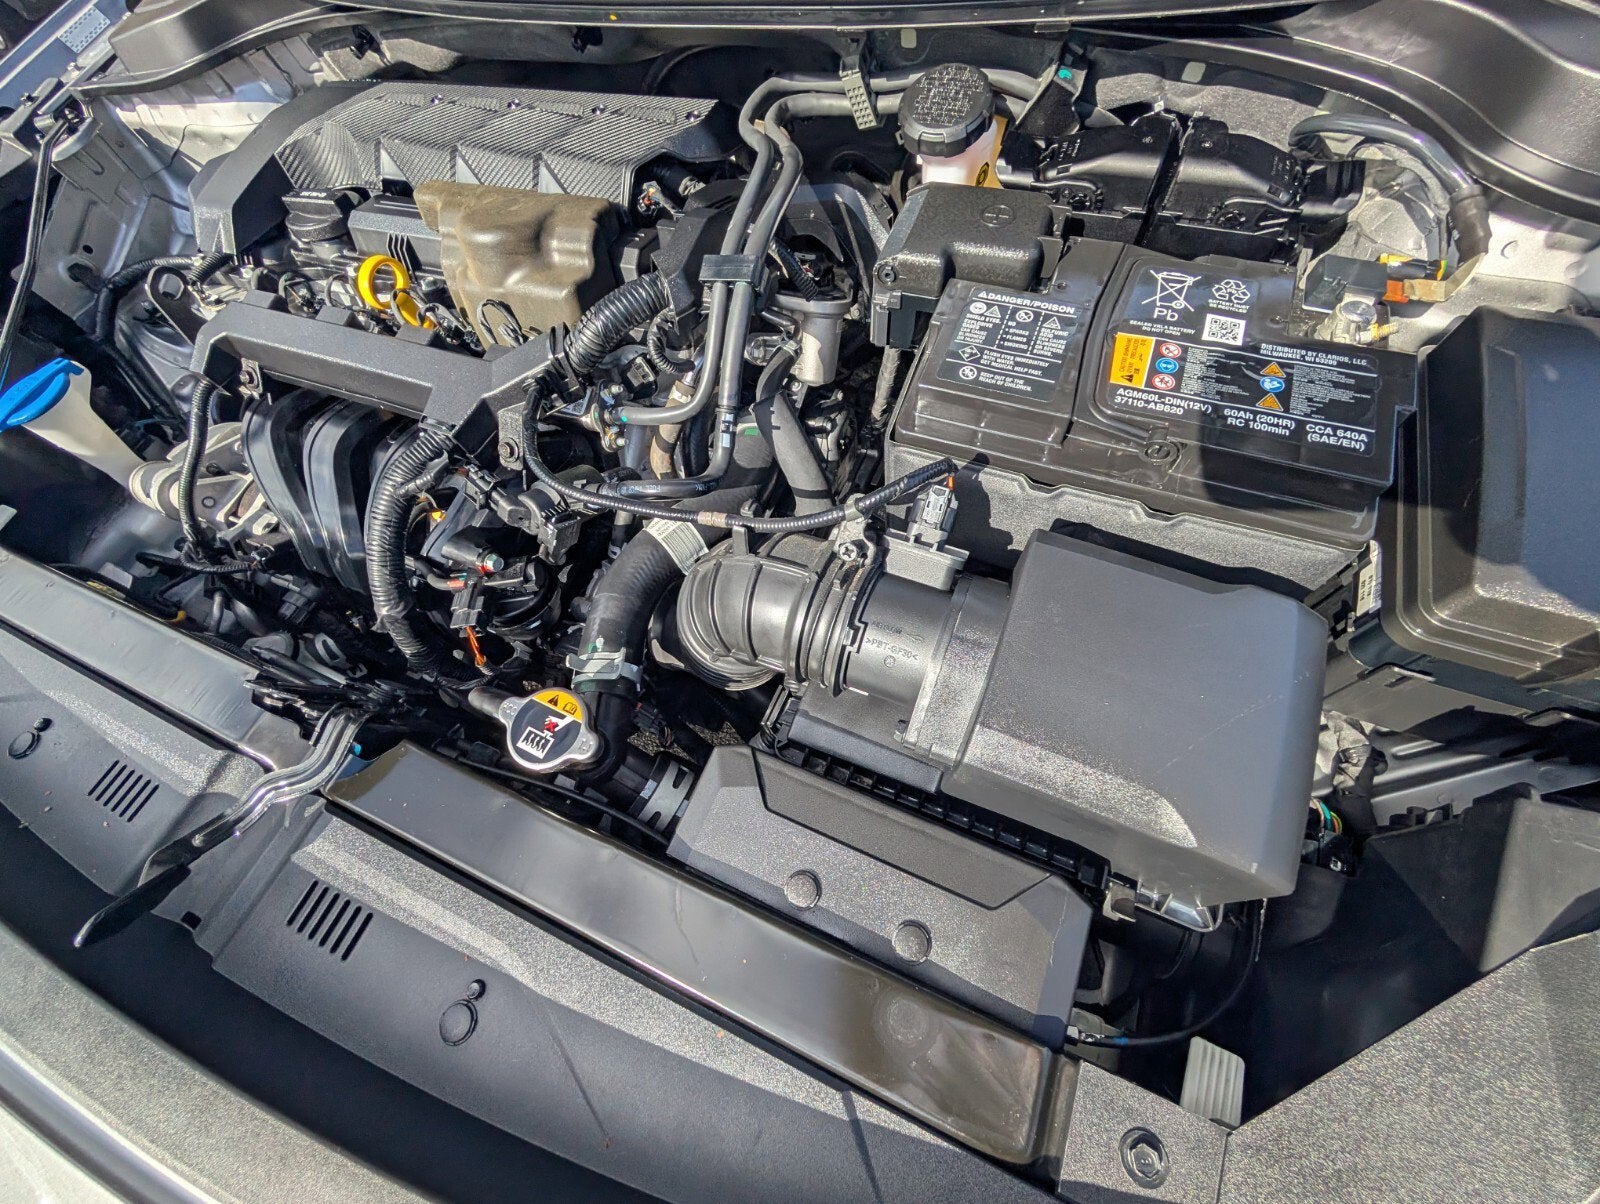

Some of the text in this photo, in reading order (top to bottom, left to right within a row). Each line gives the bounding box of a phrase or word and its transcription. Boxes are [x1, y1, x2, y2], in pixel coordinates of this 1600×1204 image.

[988, 293, 1075, 314] DANGER/POISON
[1208, 299, 1250, 310] BATTERY MUST
[1218, 304, 1248, 314] RECYCLED
[966, 313, 986, 321] SHIELD
[1153, 307, 1179, 321] Pb
[1041, 327, 1069, 336] SULFURIC
[1129, 320, 1153, 328] SEALED
[1169, 325, 1196, 335] BATTERY
[1006, 334, 1027, 342] FLAMES
[1001, 353, 1014, 361] EYES
[1015, 356, 1050, 368] IMMEDIATELY
[1260, 349, 1303, 360] MILWAUKEE,
[1315, 357, 1338, 366] 53209
[1261, 343, 1306, 356] DISTRIBUTED
[1307, 350, 1318, 358] BY
[1318, 352, 1351, 364] CLARIOS,
[991, 361, 1013, 370] MEDICAL
[979, 376, 996, 384] REACH
[1114, 395, 1184, 415] 37110-AB620
[1116, 387, 1212, 414] AGM60L-DIN(12V)
[1223, 408, 1296, 430] 60Ah (20HR)
[1226, 417, 1290, 436] RC 100min
[1306, 423, 1368, 442] CCA 640A
[1307, 432, 1365, 452] (SAE/EN)
